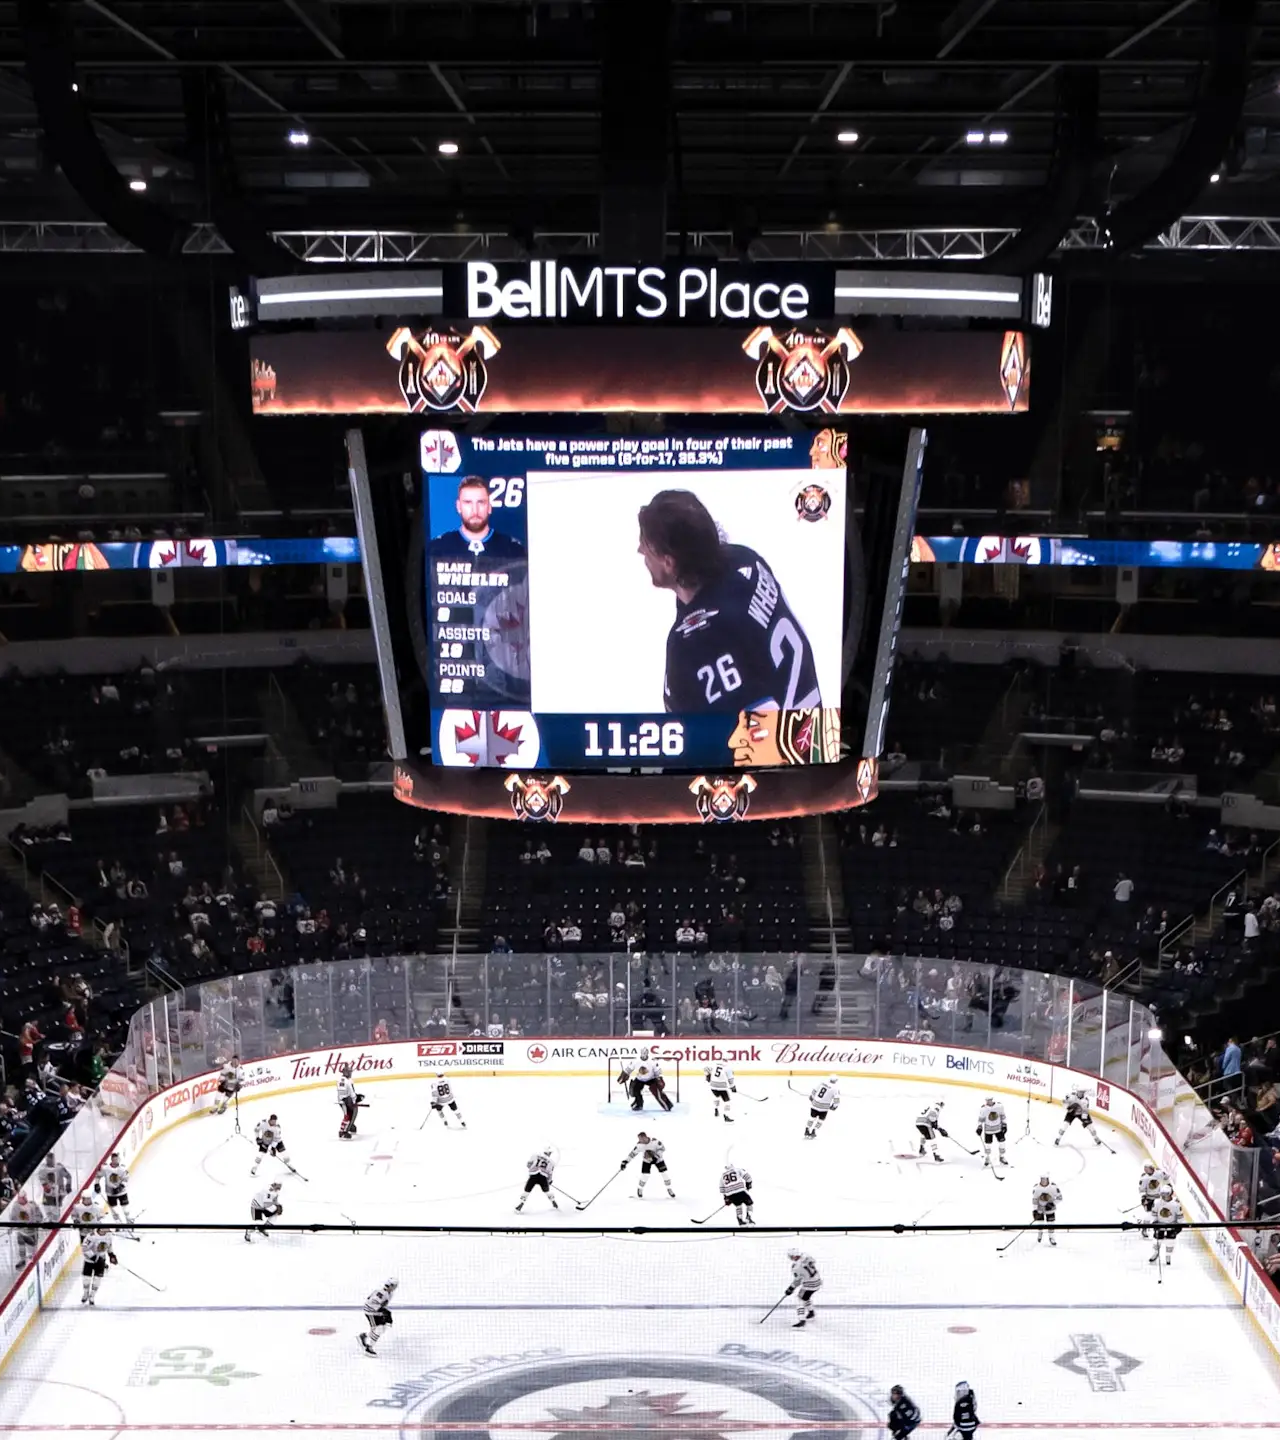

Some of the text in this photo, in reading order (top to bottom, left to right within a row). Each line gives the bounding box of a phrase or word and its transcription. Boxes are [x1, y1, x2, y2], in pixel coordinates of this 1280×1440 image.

[679, 267, 809, 319] Place
[471, 437, 793, 454] The Jets have a power play goal in four of their past
[545, 453, 570, 465] five
[572, 455, 616, 467] games
[489, 478, 525, 508] 26
[437, 562, 472, 573] BLAKE
[437, 573, 509, 587] WHEELER
[437, 591, 477, 605] GOALS
[438, 627, 490, 640] ASSISTS
[439, 663, 485, 677] POINTS
[697, 654, 742, 704] 26
[584, 722, 685, 757] 11:26
[466, 1044, 501, 1054] DIRECT
[551, 1047, 638, 1058] AIR CANADA
[650, 1045, 762, 1062] Scotiabank
[771, 1043, 883, 1065] Budweiser
[418, 1058, 504, 1067] TSN.CA/SUBSCRIBE
[893, 1053, 936, 1067] Fibe TV
[946, 1054, 995, 1075] BellMTS
[290, 1056, 321, 1080] Tim
[714, 1066, 723, 1077] 5
[437, 1084, 449, 1096] 88
[818, 1087, 826, 1098] 8
[163, 1088, 190, 1117] pizza
[1131, 1104, 1156, 1149] NISSAN
[723, 1171, 737, 1185] 36
